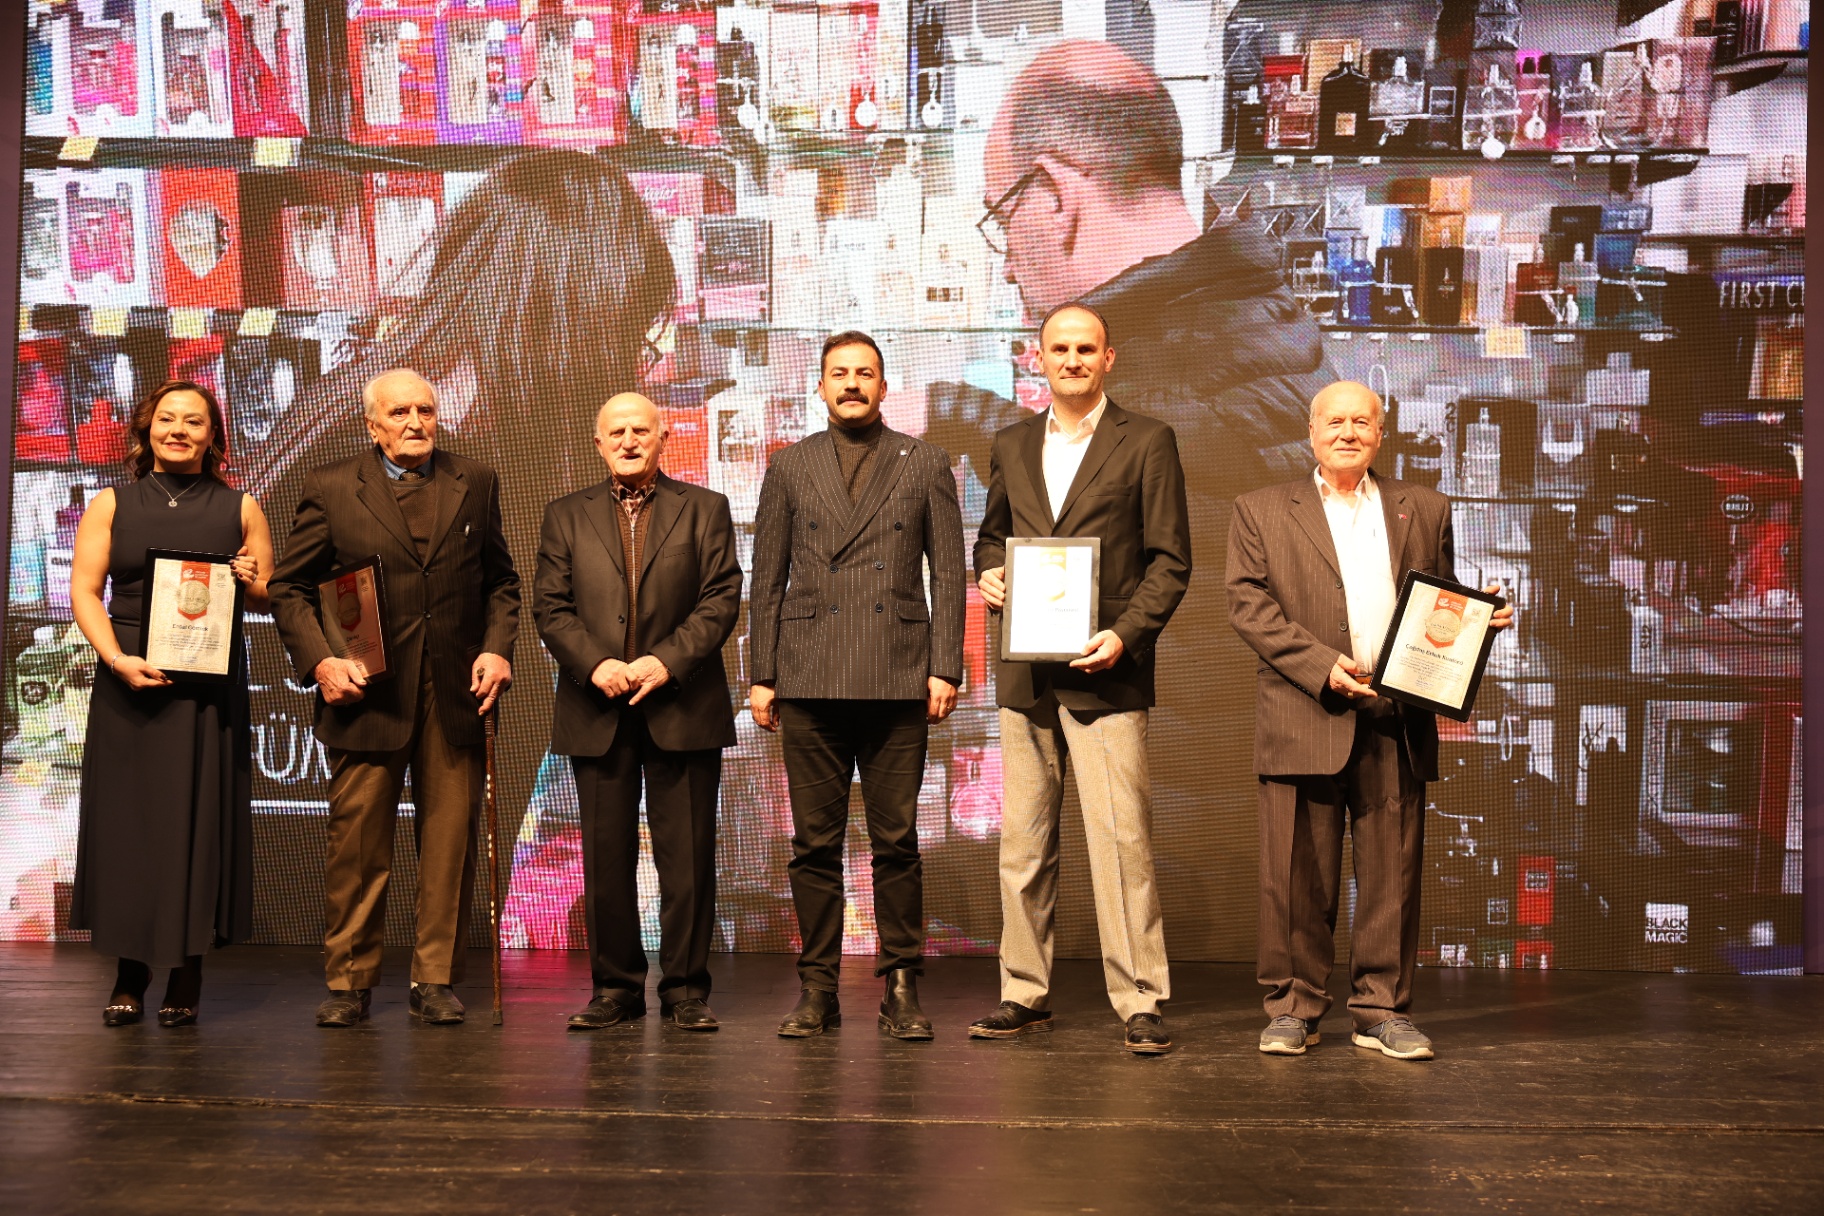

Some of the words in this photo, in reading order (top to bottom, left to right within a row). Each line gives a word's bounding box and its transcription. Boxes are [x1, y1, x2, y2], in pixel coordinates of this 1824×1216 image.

[1720, 281, 1779, 308] FIRST
[1646, 917, 1688, 928] BLACK
[1645, 930, 1688, 944] MAGIC
